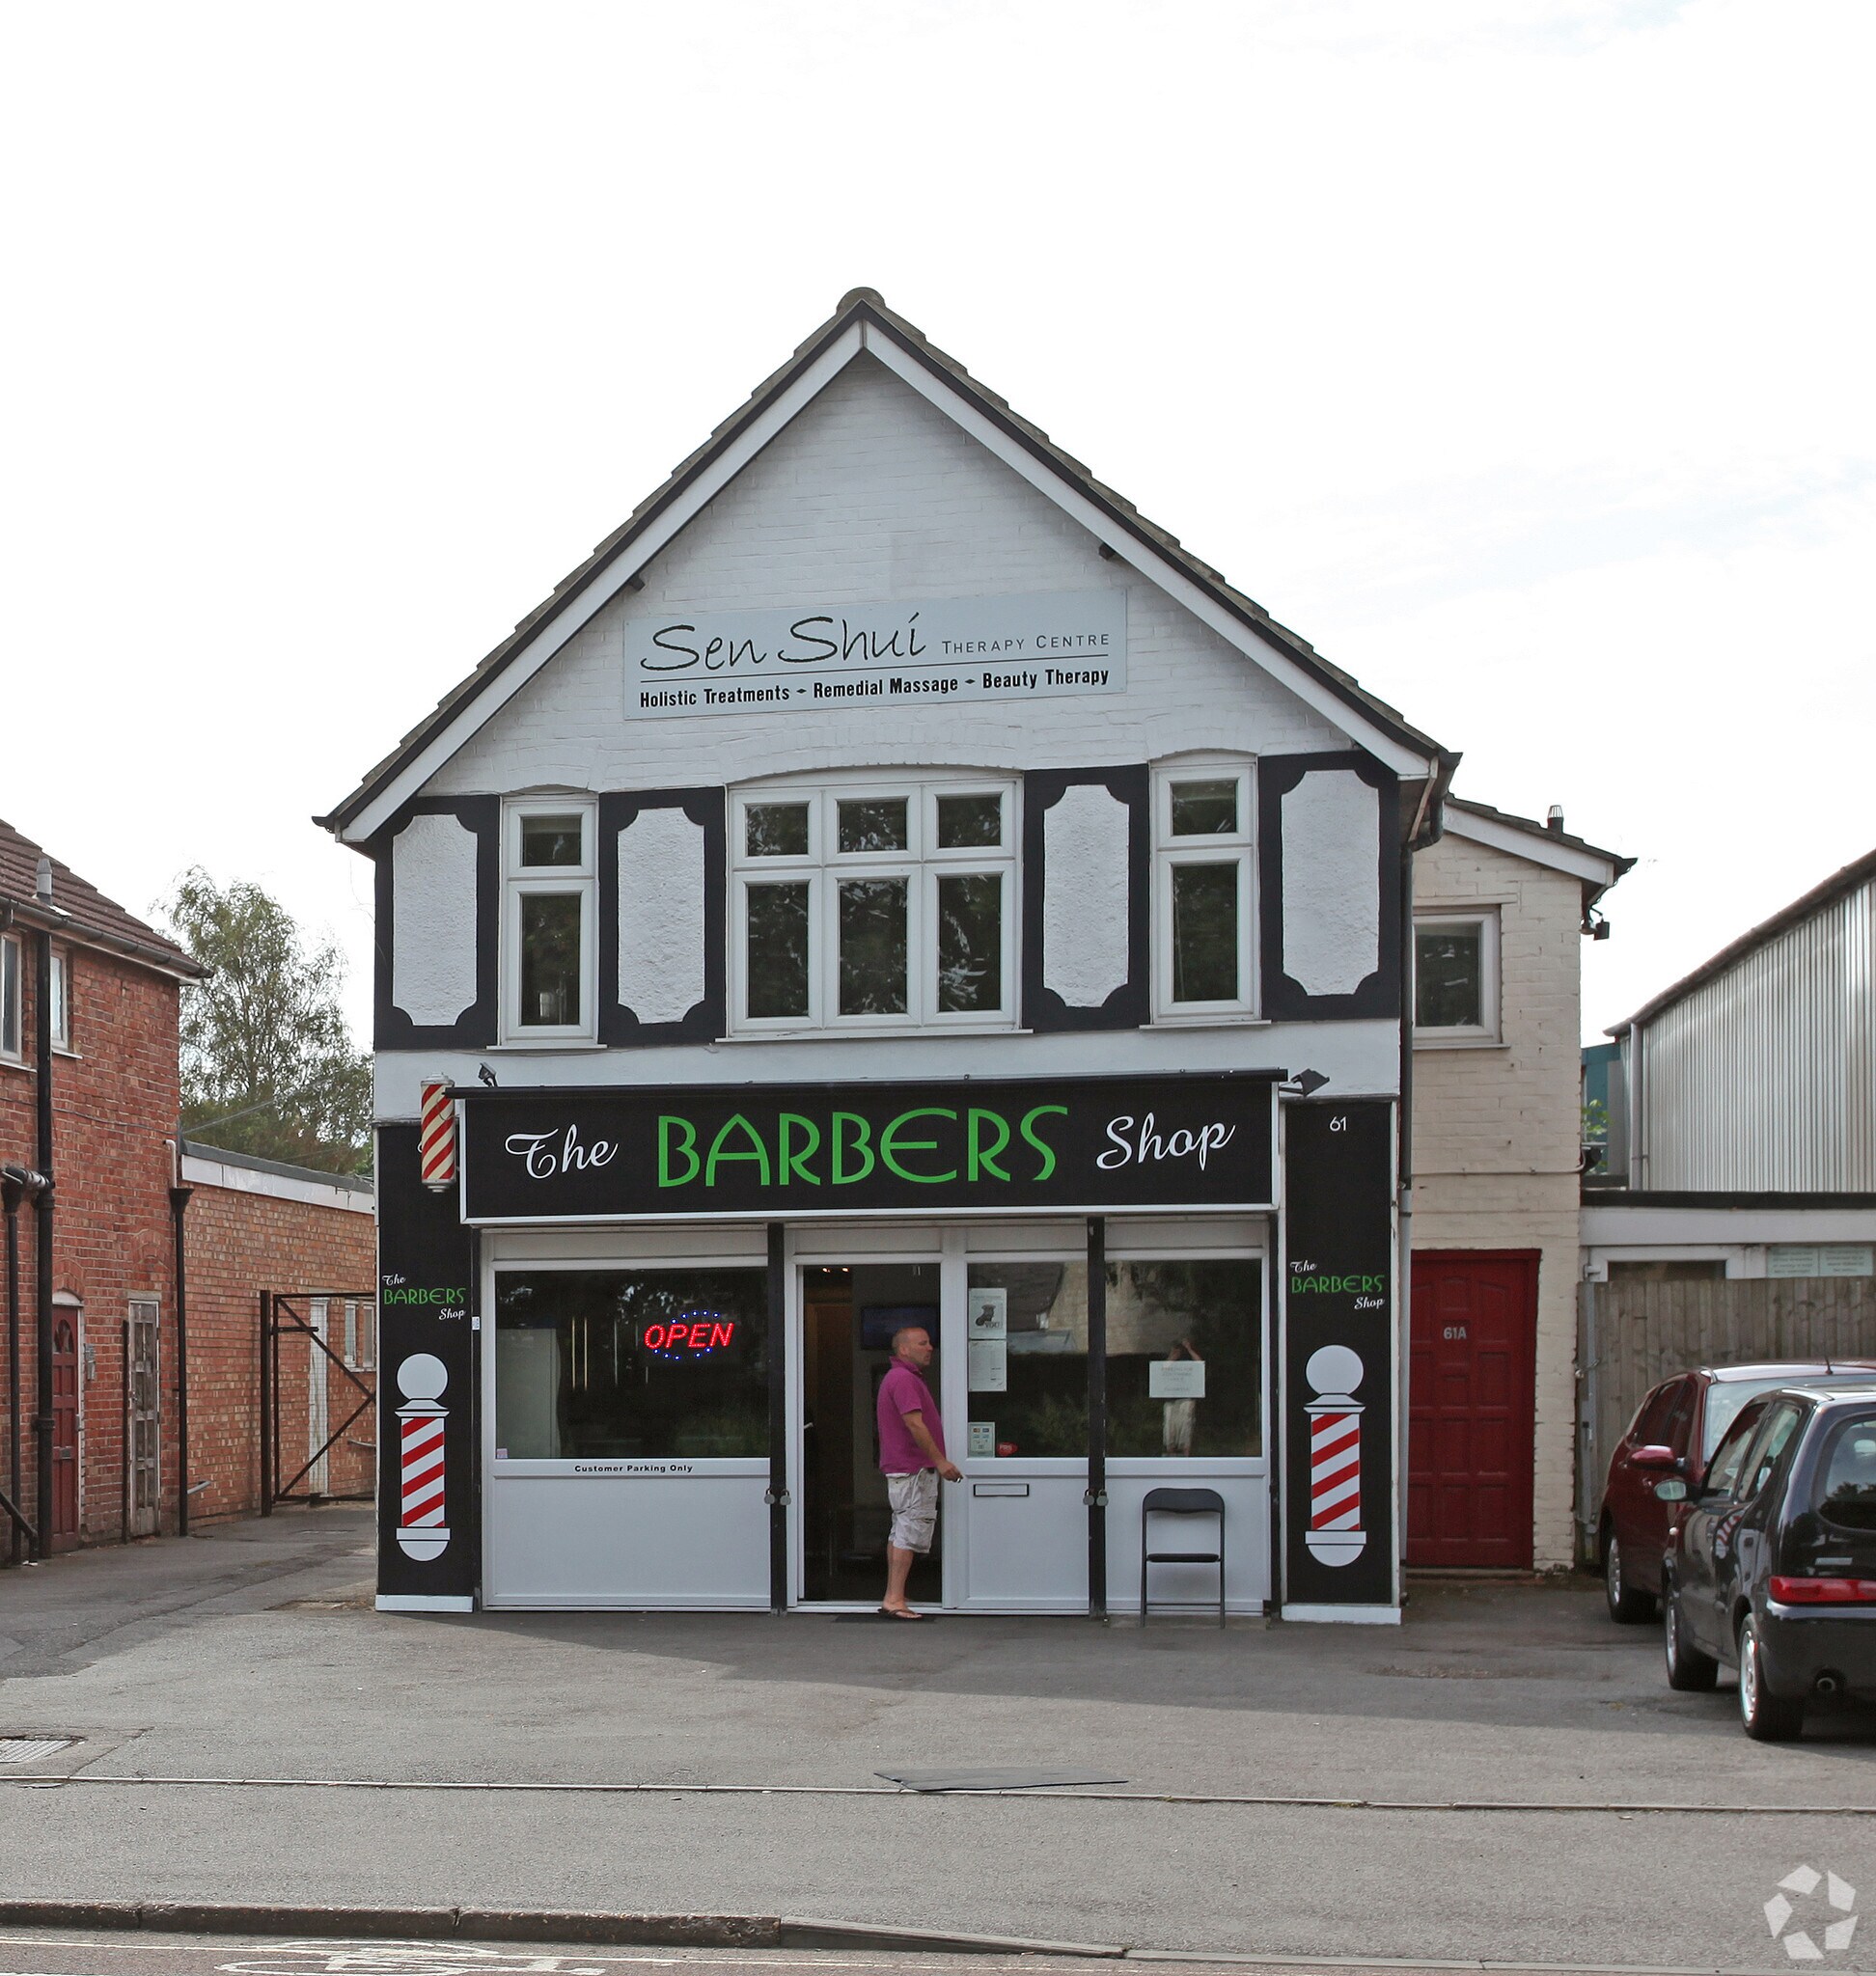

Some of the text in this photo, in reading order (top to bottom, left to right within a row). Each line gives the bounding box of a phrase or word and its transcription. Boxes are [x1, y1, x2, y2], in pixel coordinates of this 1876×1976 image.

[640, 611, 1111, 672] Sen Shui THERAPY CENTRE
[640, 667, 1110, 709] Holistic Treatments Remedial Massage Beauty Therapy
[1329, 1115, 1347, 1132] 61
[504, 1104, 1236, 1188] The BARBERS Shop
[1289, 1259, 1317, 1274] The
[381, 1274, 406, 1286] The
[1291, 1275, 1385, 1294] BARBERS
[384, 1287, 467, 1304] BARBERS
[1354, 1296, 1385, 1310] Shop
[438, 1307, 466, 1321] Shop
[644, 1322, 735, 1349] OPEN
[1443, 1327, 1467, 1340] 61A
[626, 1465, 666, 1473] Parking
[669, 1464, 693, 1473] Only
